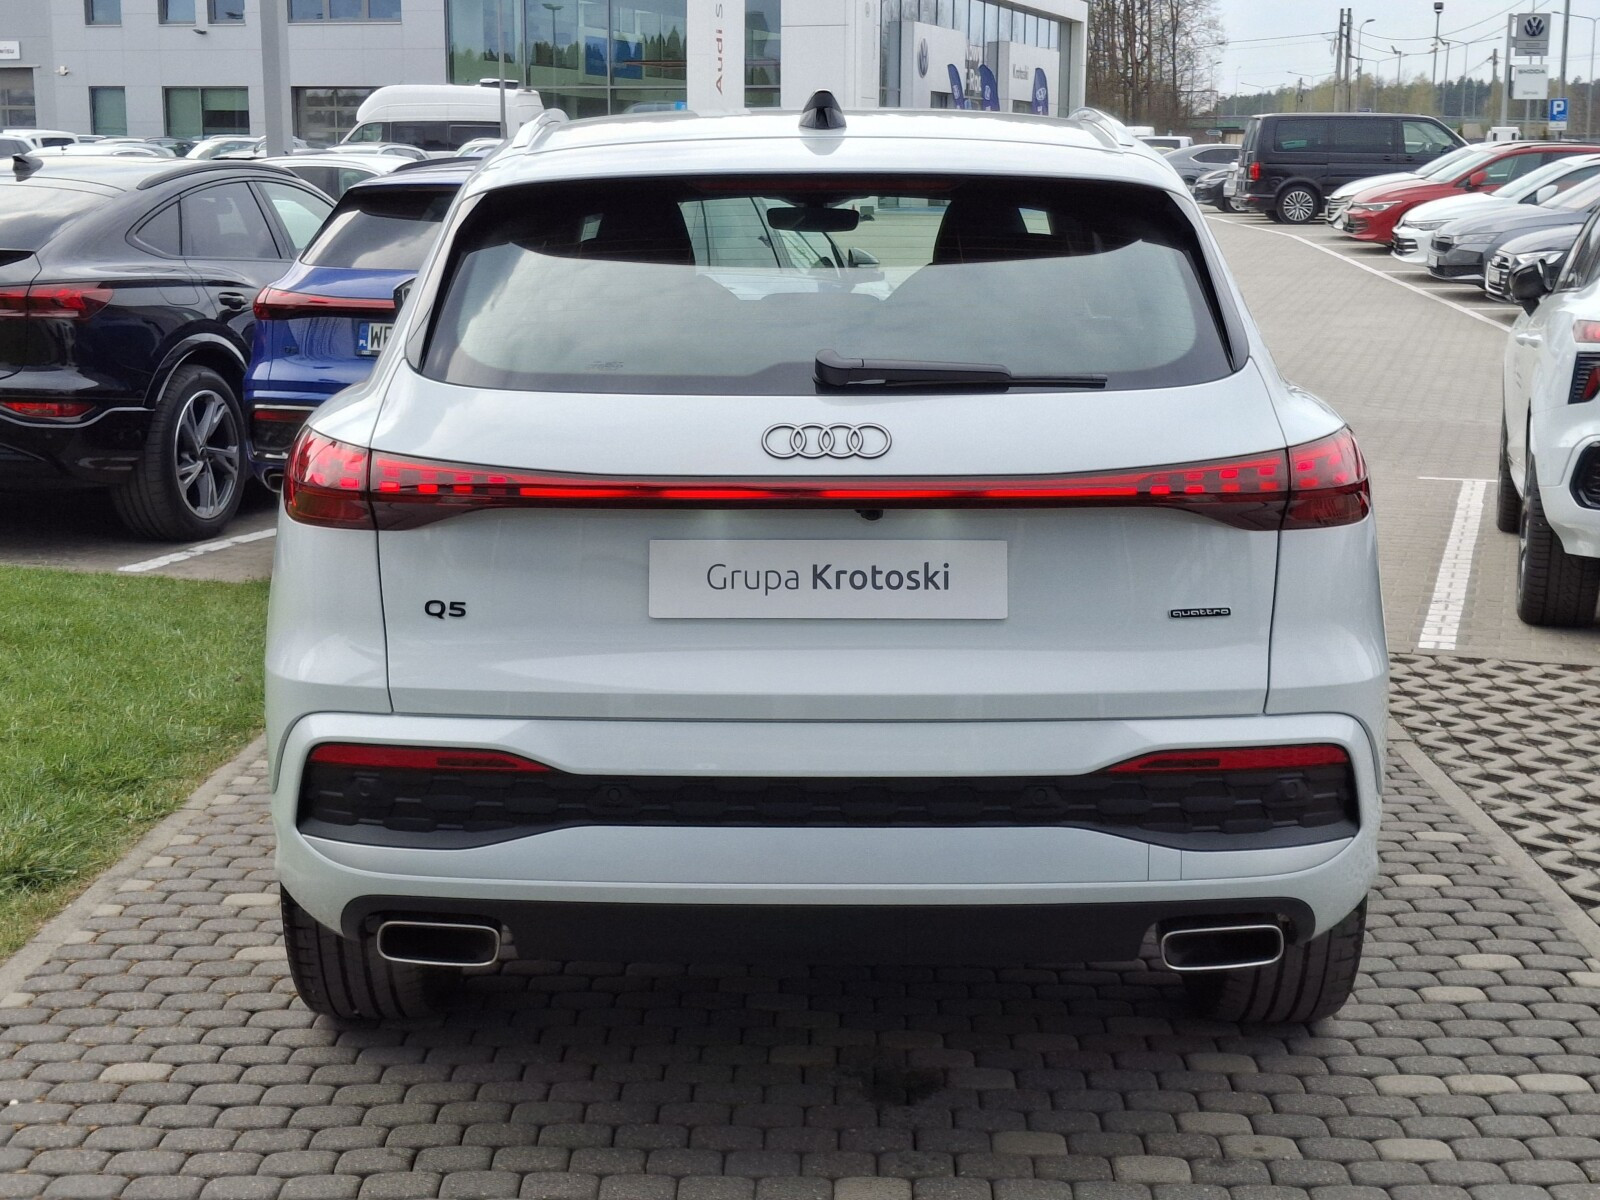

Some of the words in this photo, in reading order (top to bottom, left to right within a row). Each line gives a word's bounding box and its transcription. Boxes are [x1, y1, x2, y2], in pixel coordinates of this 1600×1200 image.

[1552, 101, 1565, 116] P
[706, 563, 800, 596] Grupa
[811, 562, 951, 591] Krotoski
[424, 600, 466, 619] Q5
[1171, 608, 1230, 618] quattro
